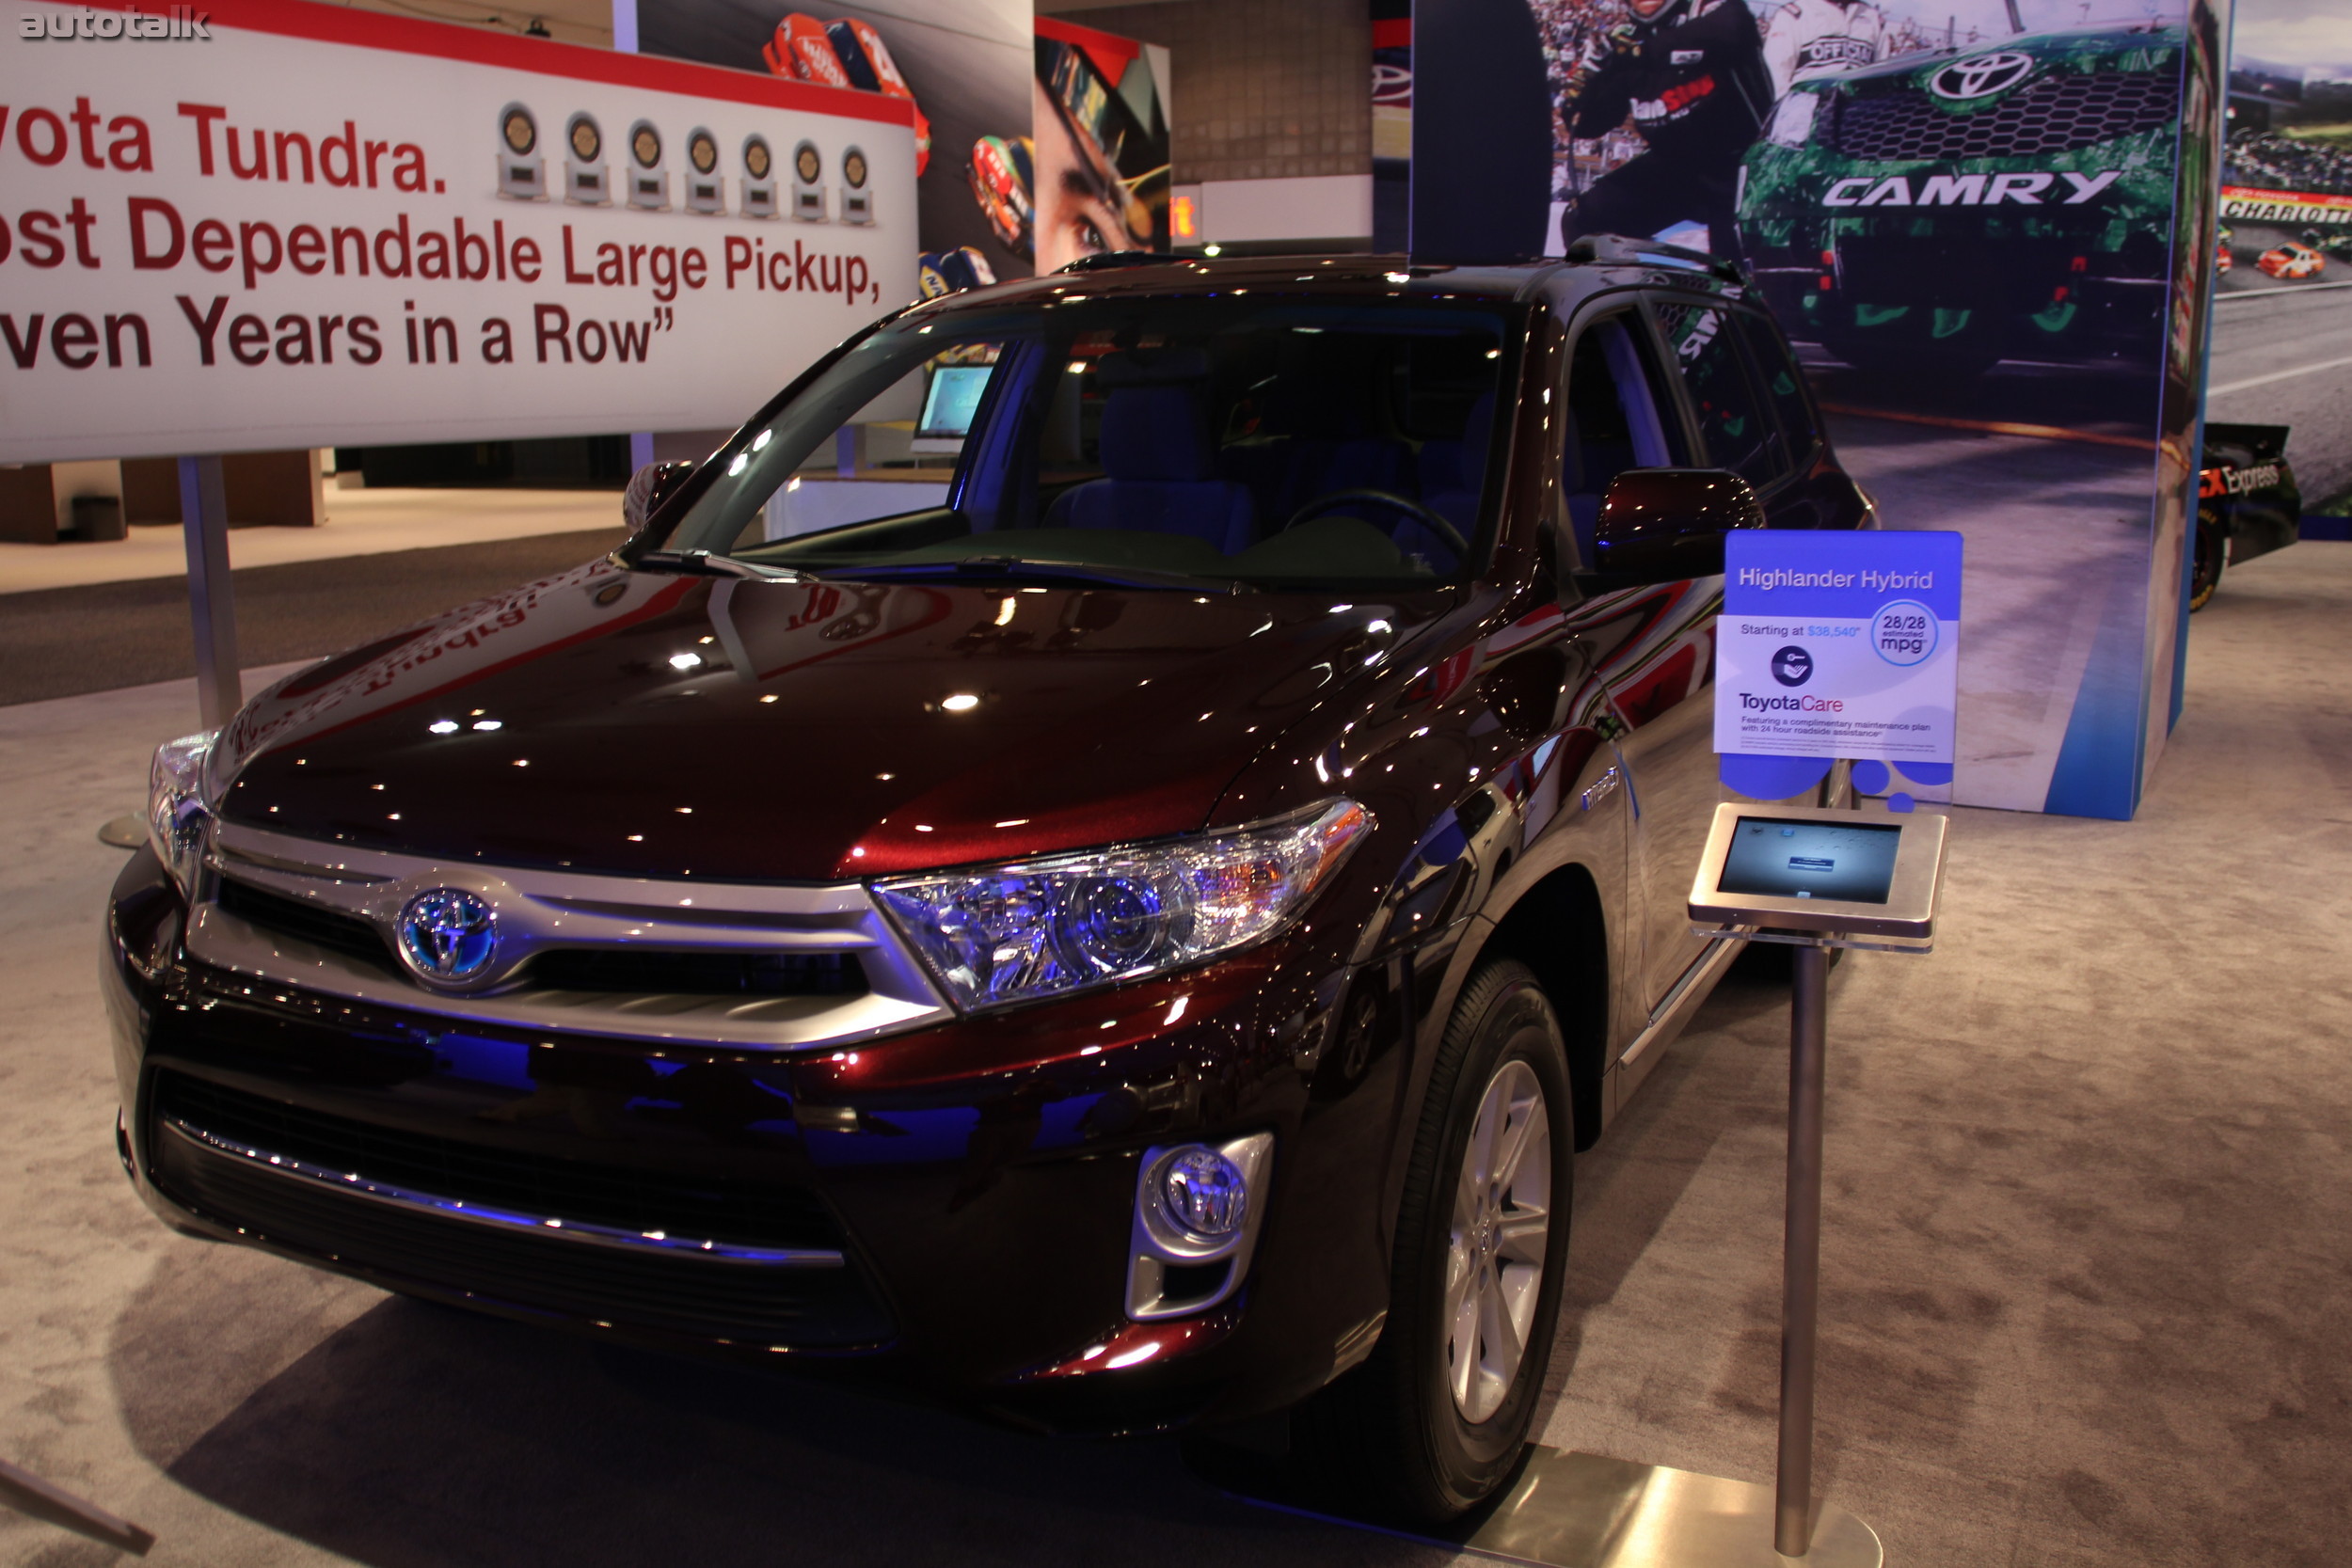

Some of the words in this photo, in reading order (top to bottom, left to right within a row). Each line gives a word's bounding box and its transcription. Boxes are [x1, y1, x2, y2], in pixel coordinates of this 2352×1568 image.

[0, 95, 153, 173] ota
[177, 102, 446, 194] Tundra.
[1821, 171, 2122, 207] CAMRY
[2225, 201, 2352, 223] CHARLOTT
[0, 197, 102, 270] st
[127, 196, 543, 290] Dependable
[562, 224, 707, 302] Large
[723, 235, 880, 305] Pickup,
[175, 294, 383, 367] Years
[404, 300, 458, 364] in
[480, 317, 513, 364] a
[2221, 465, 2280, 496] Express
[1740, 567, 1855, 591] Highlander
[1861, 569, 1934, 593] Hybrid
[1740, 624, 1788, 638] Starting
[1792, 625, 1804, 636] at
[1883, 615, 1927, 630] 28/28
[1739, 692, 1844, 713] ToyotaCare
[1741, 716, 1781, 726] Featuring
[1789, 718, 1853, 730] complimentary
[1854, 721, 1910, 731] maintenance
[1912, 723, 1931, 732] plan
[1772, 726, 1792, 735] hour
[1794, 727, 1831, 736] roadside
